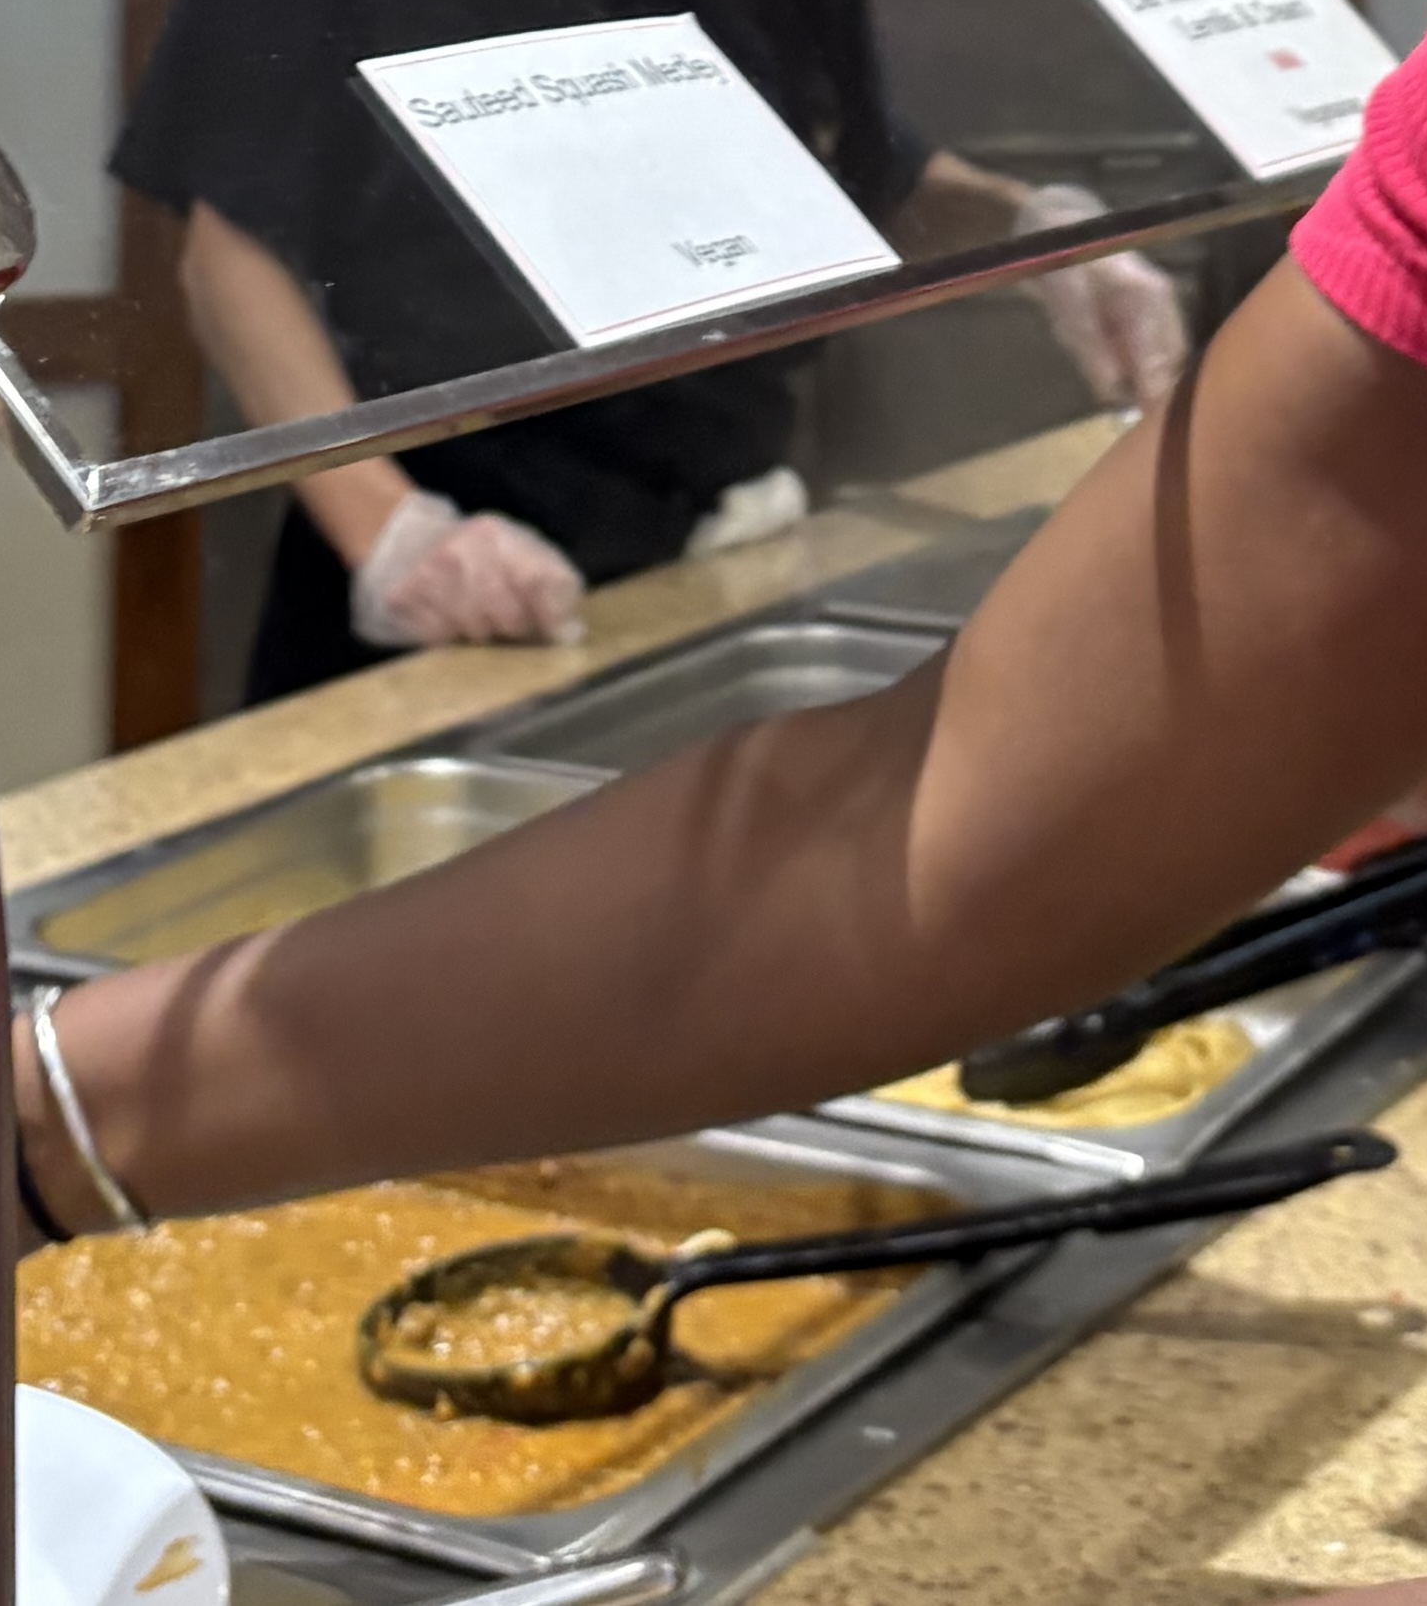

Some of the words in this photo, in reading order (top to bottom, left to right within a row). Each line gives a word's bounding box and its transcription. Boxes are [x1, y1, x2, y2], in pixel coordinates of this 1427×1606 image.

[531, 61, 639, 106] Squash
[627, 53, 731, 87] Medley
[671, 234, 759, 268] Vegan
